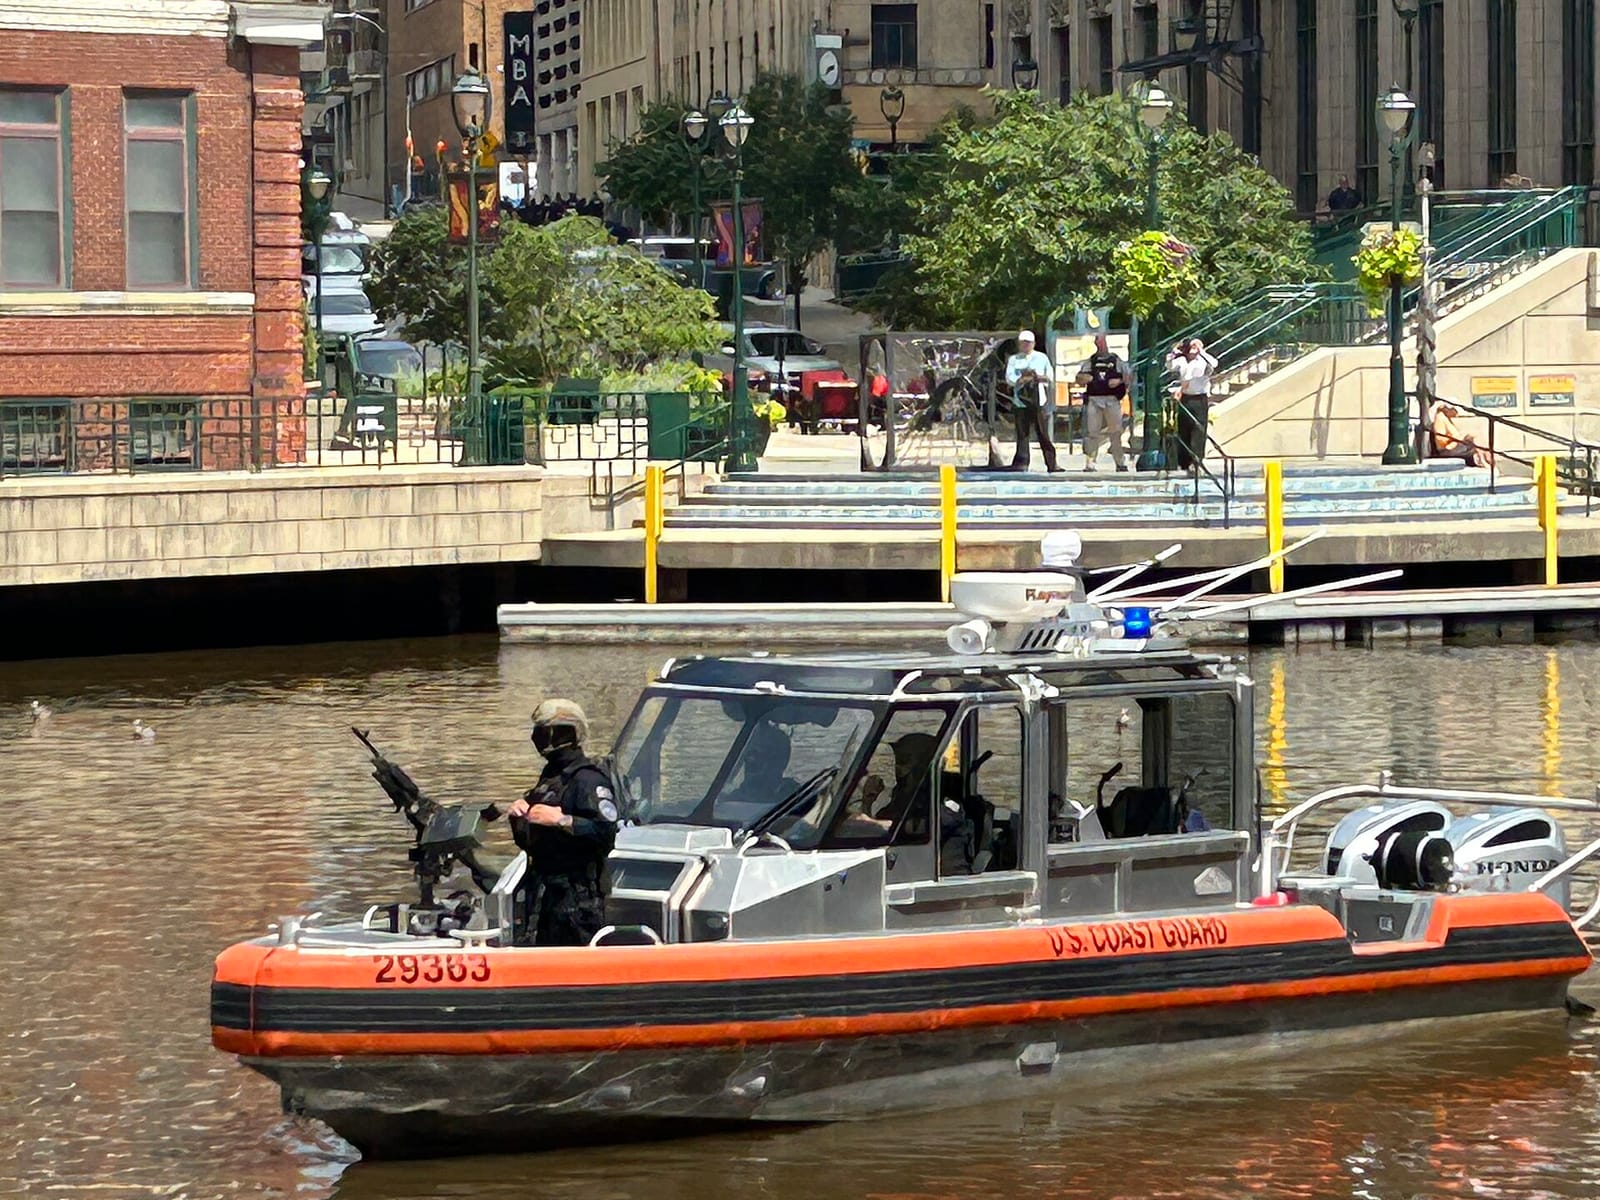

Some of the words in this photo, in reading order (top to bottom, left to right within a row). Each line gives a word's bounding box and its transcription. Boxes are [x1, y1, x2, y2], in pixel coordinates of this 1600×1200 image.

[509, 34, 531, 106] MBA
[1088, 921, 1154, 953] COAST
[1158, 917, 1227, 948] GUARD
